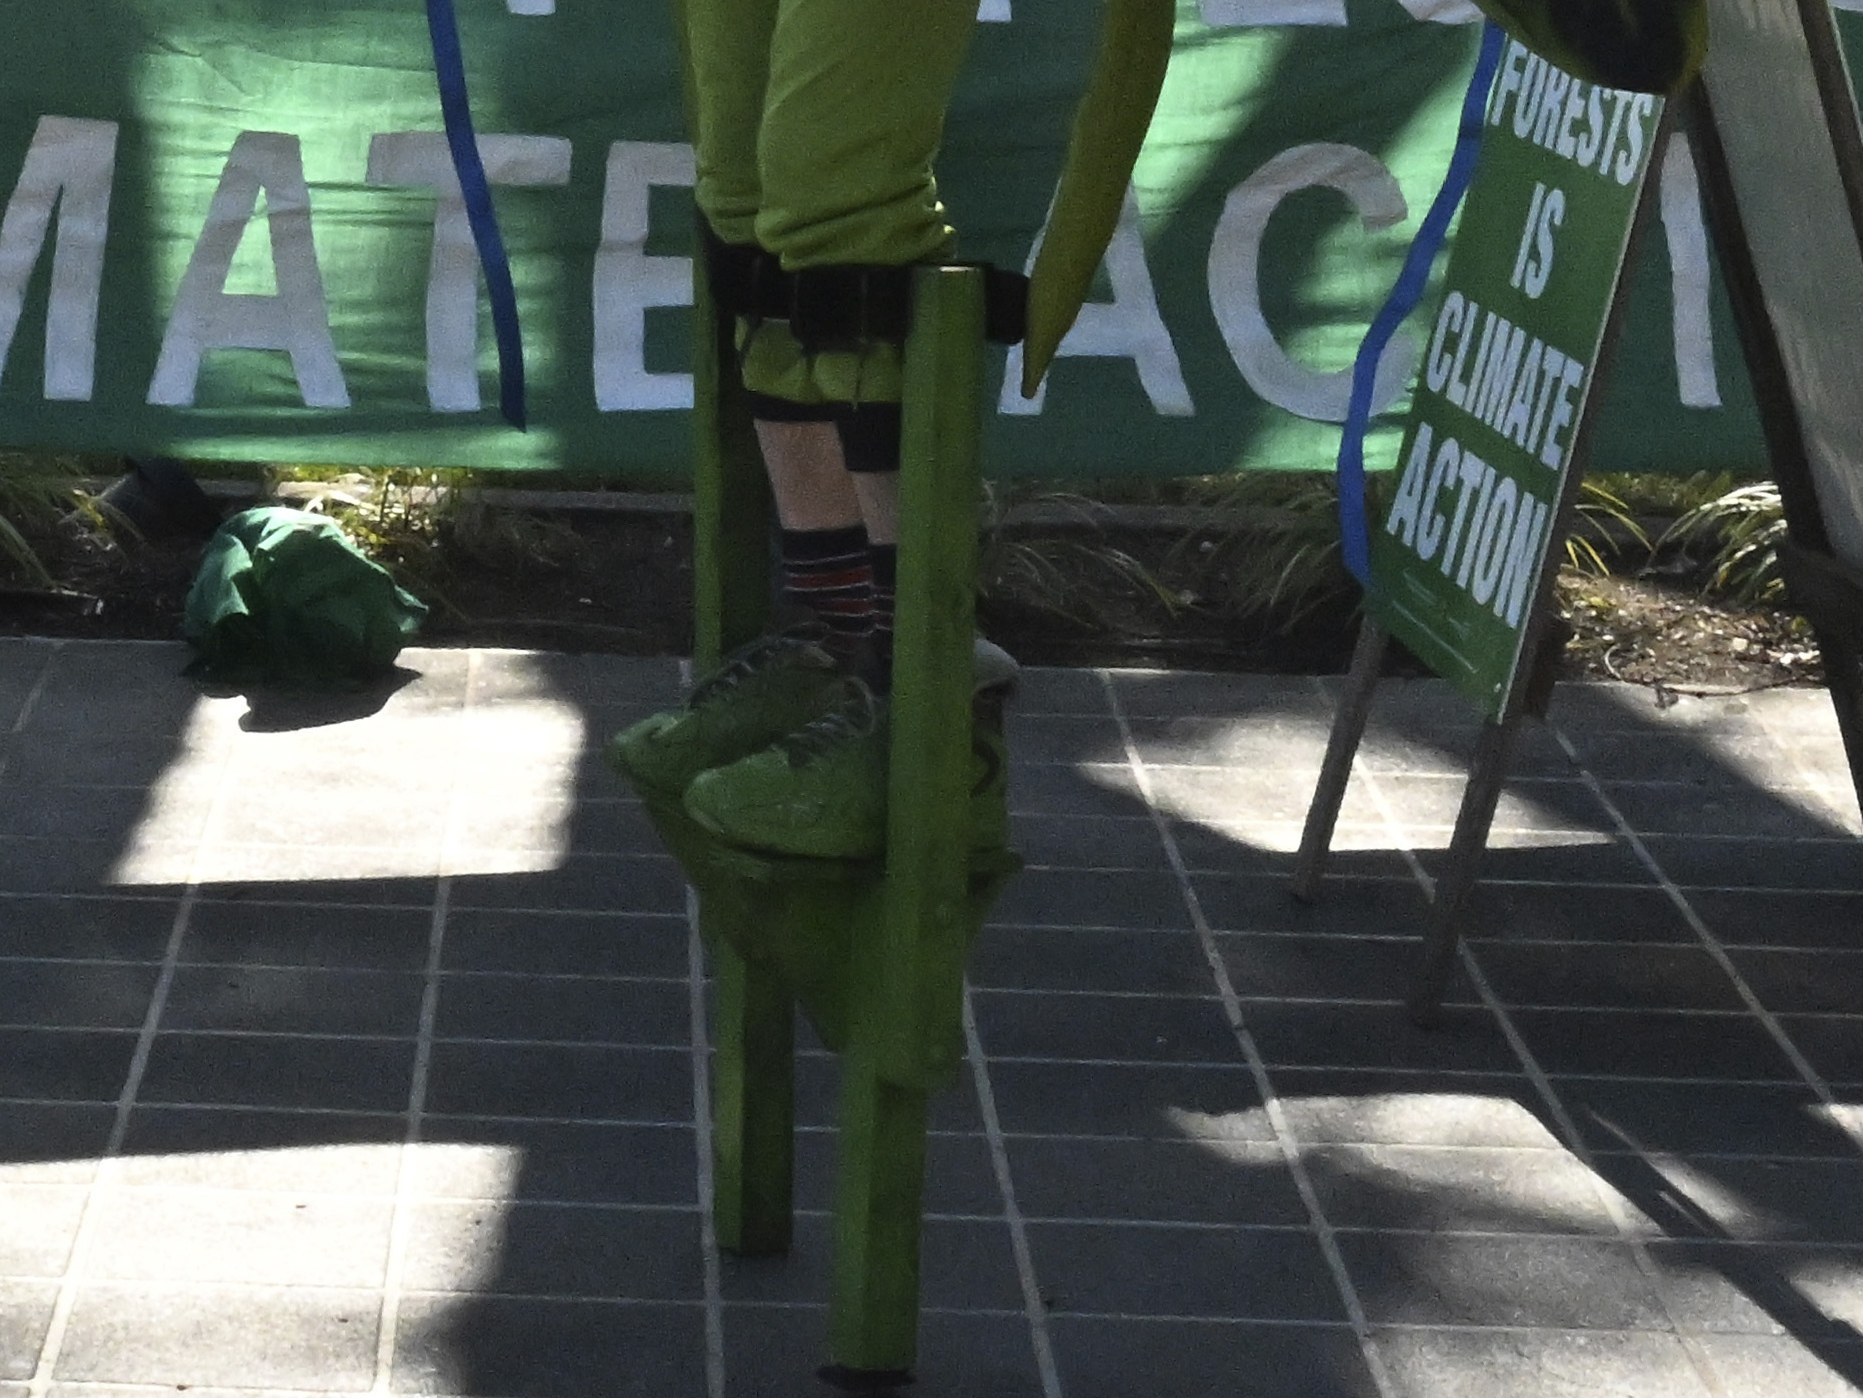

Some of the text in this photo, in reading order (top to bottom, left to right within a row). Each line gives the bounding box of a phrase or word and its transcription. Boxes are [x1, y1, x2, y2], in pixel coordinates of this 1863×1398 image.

[1490, 38, 1654, 186] FORESTS
[1510, 181, 1566, 299] IS
[1426, 289, 1585, 471] CLIMATE
[1386, 421, 1548, 629] ACTION
